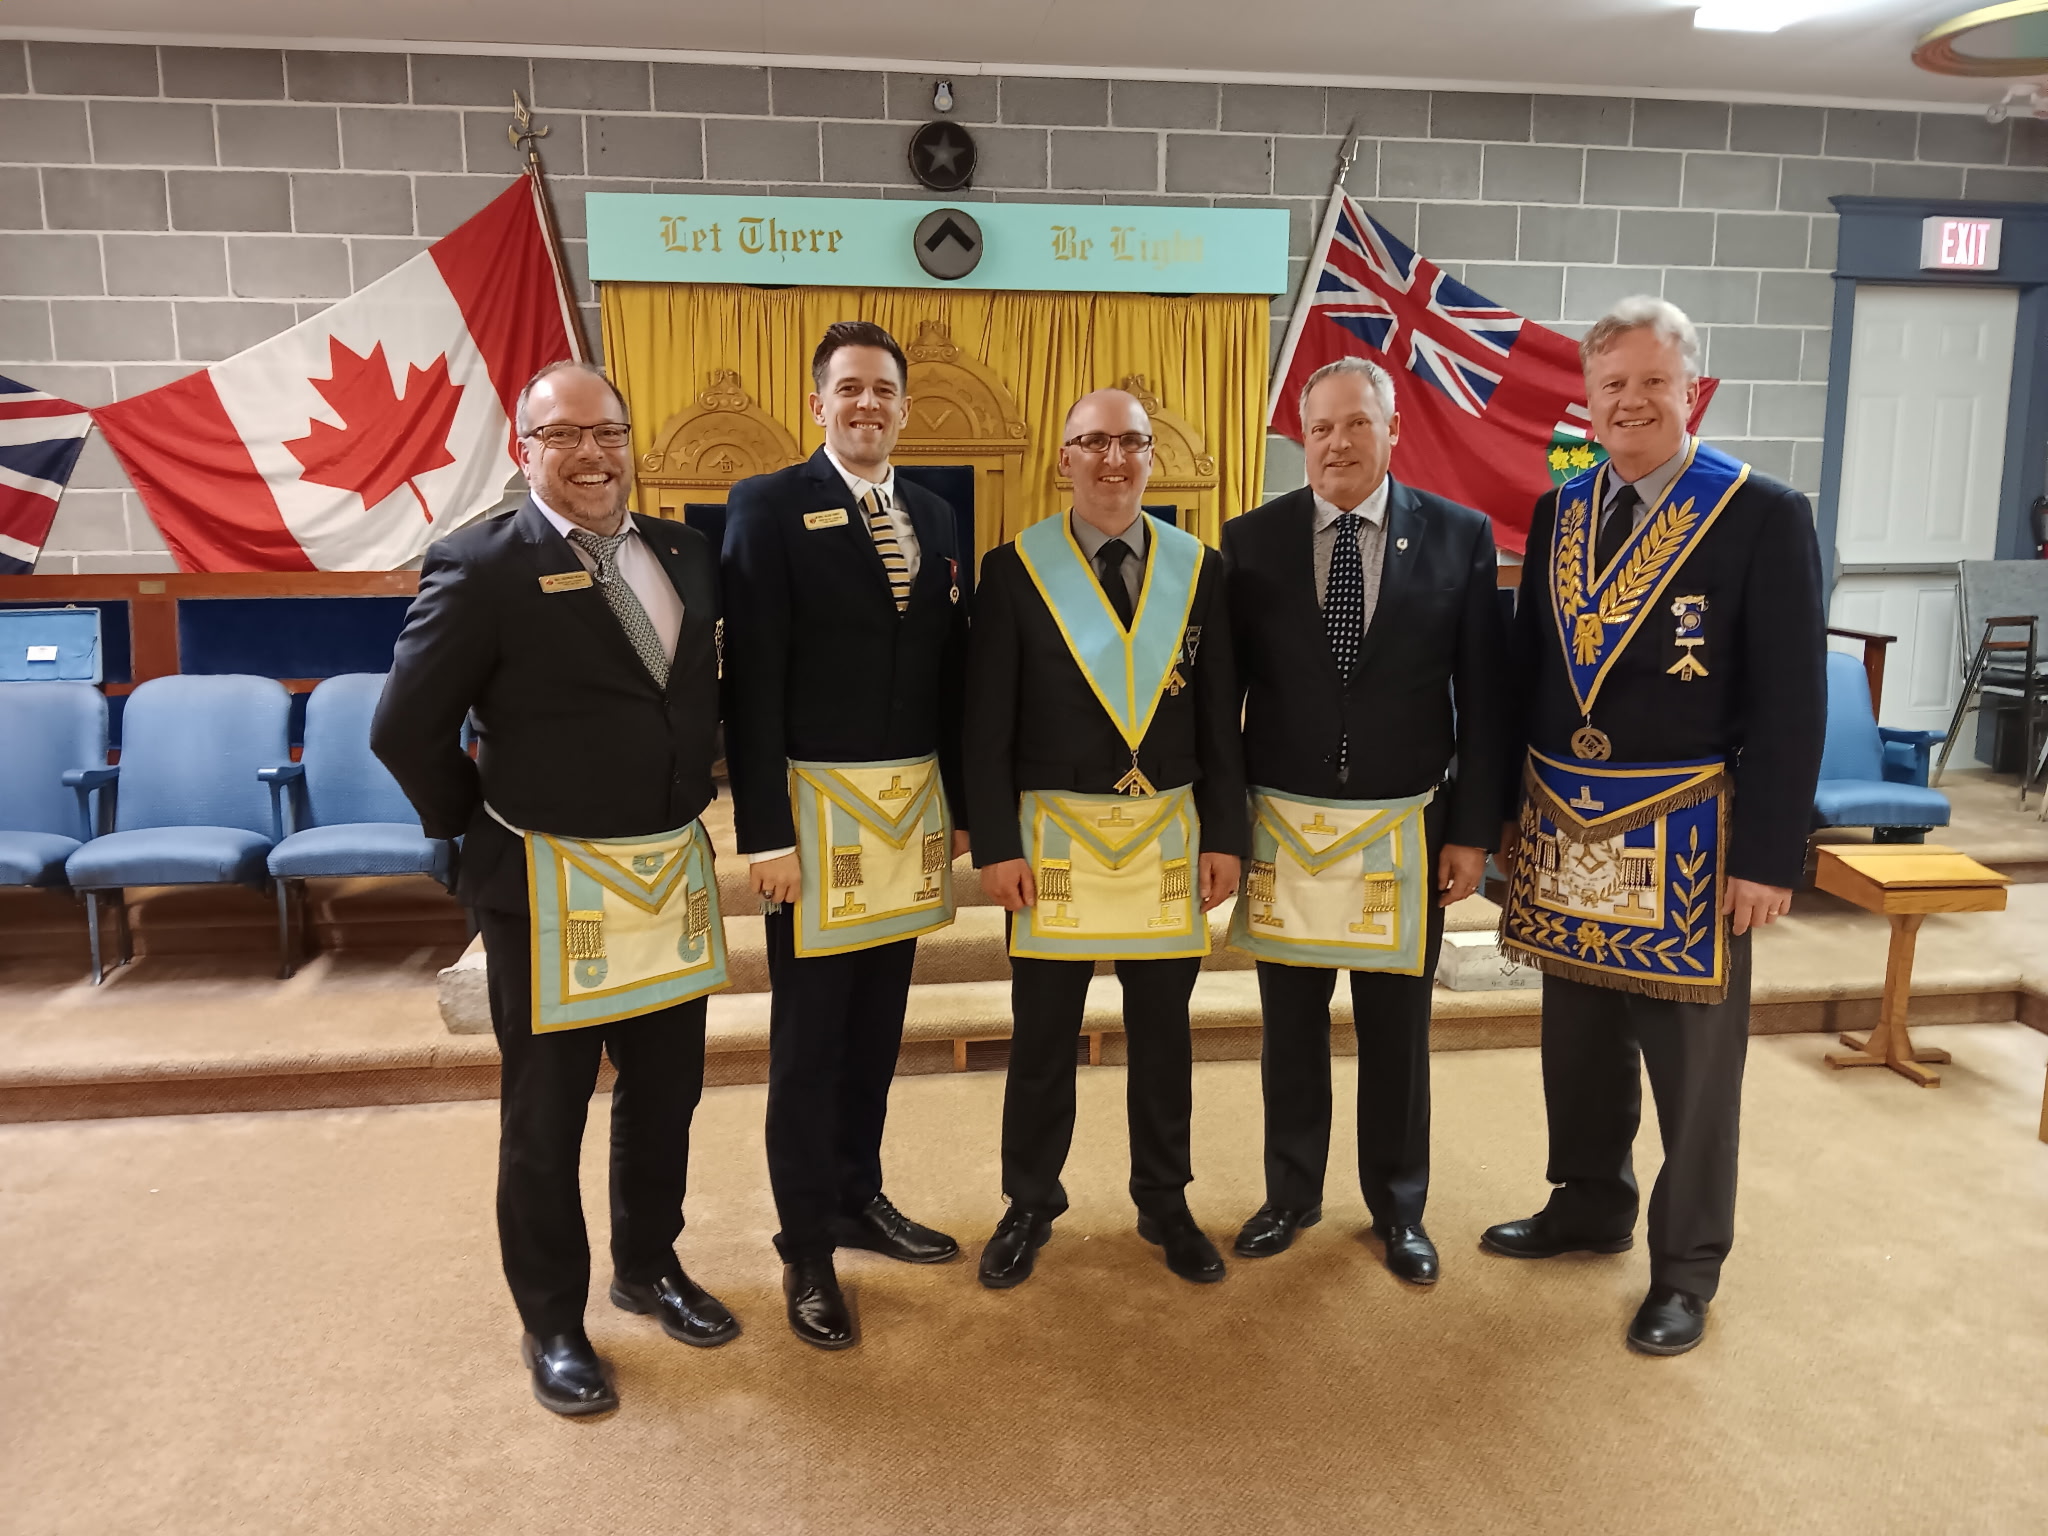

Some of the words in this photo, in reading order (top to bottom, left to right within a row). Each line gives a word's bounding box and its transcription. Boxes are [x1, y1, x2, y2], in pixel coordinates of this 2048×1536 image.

[659, 215, 722, 253] Let
[738, 216, 843, 263] There
[1051, 225, 1094, 261] Be
[1941, 222, 1991, 266] EXIT
